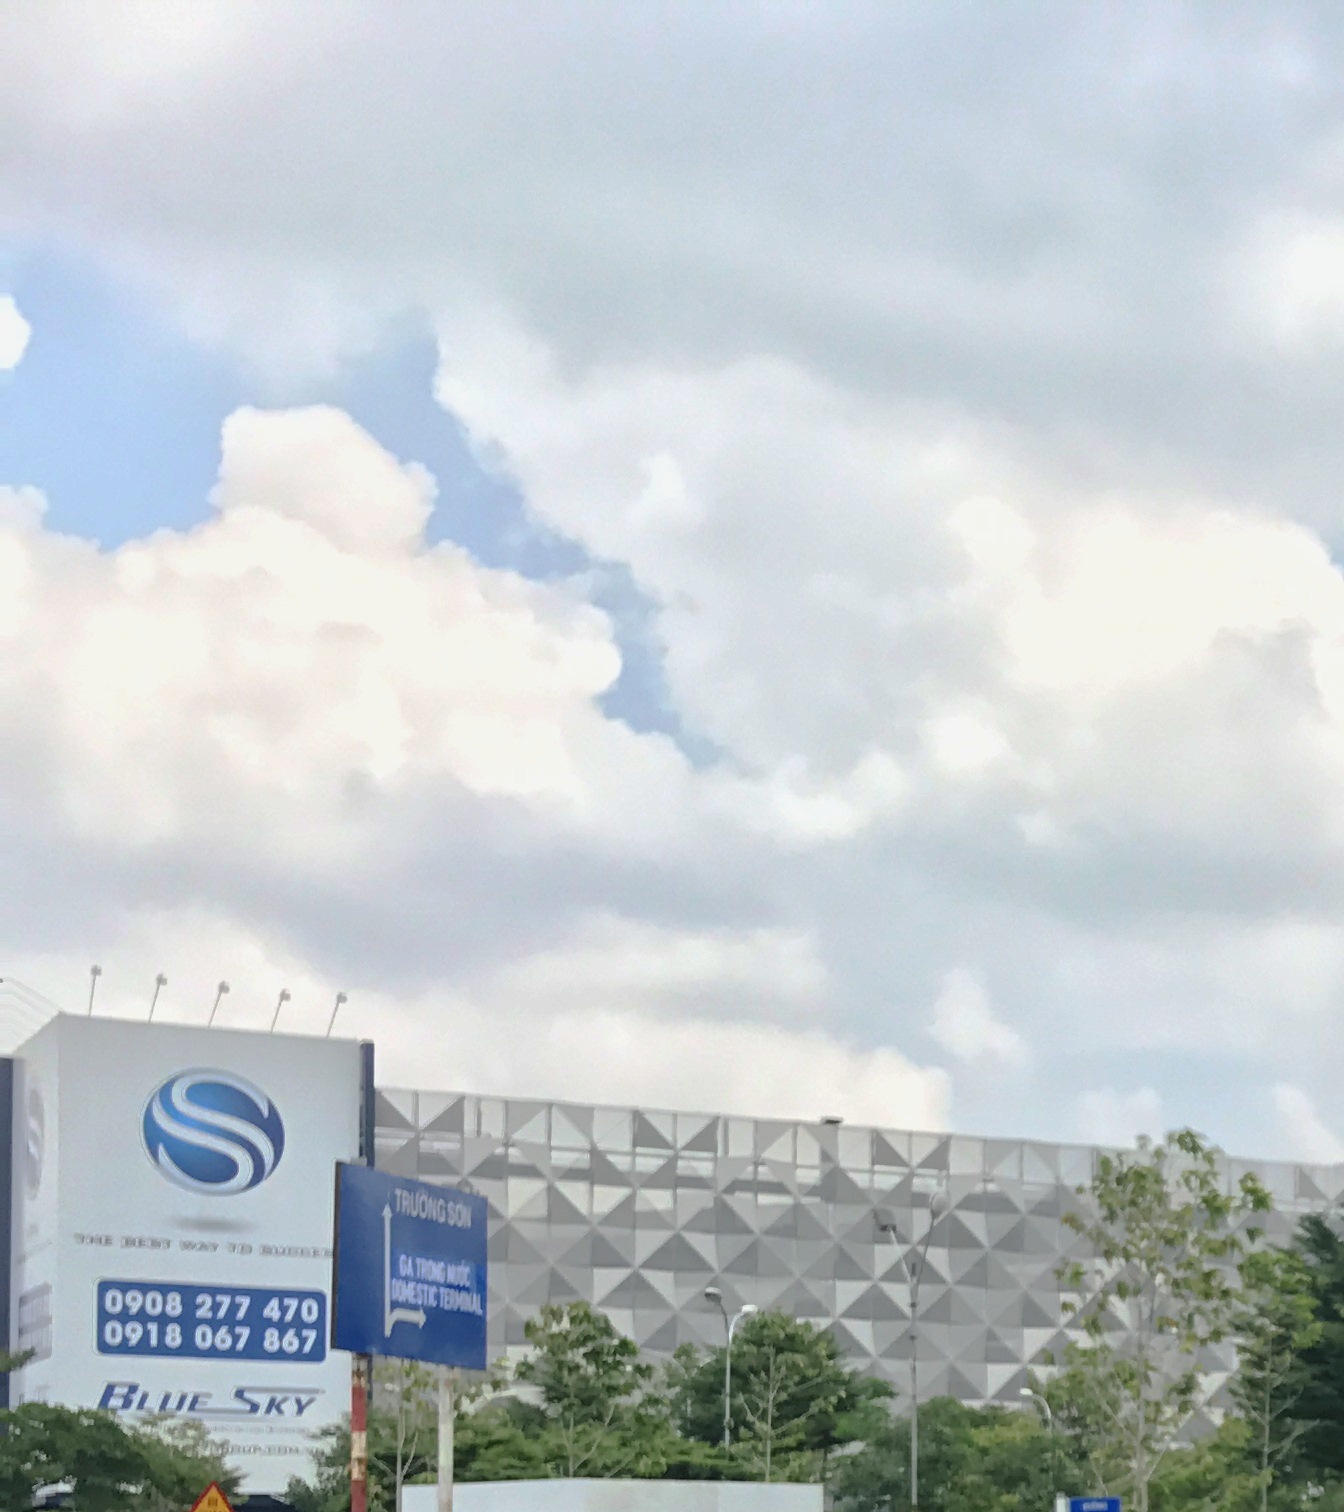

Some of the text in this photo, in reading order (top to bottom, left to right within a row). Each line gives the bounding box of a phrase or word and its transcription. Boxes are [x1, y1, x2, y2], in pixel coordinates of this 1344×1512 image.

[104, 1288, 319, 1324] 0908 277 470
[391, 1278, 483, 1317] DOMESTIC TERMINAL
[104, 1320, 318, 1355] 0918 067 867
